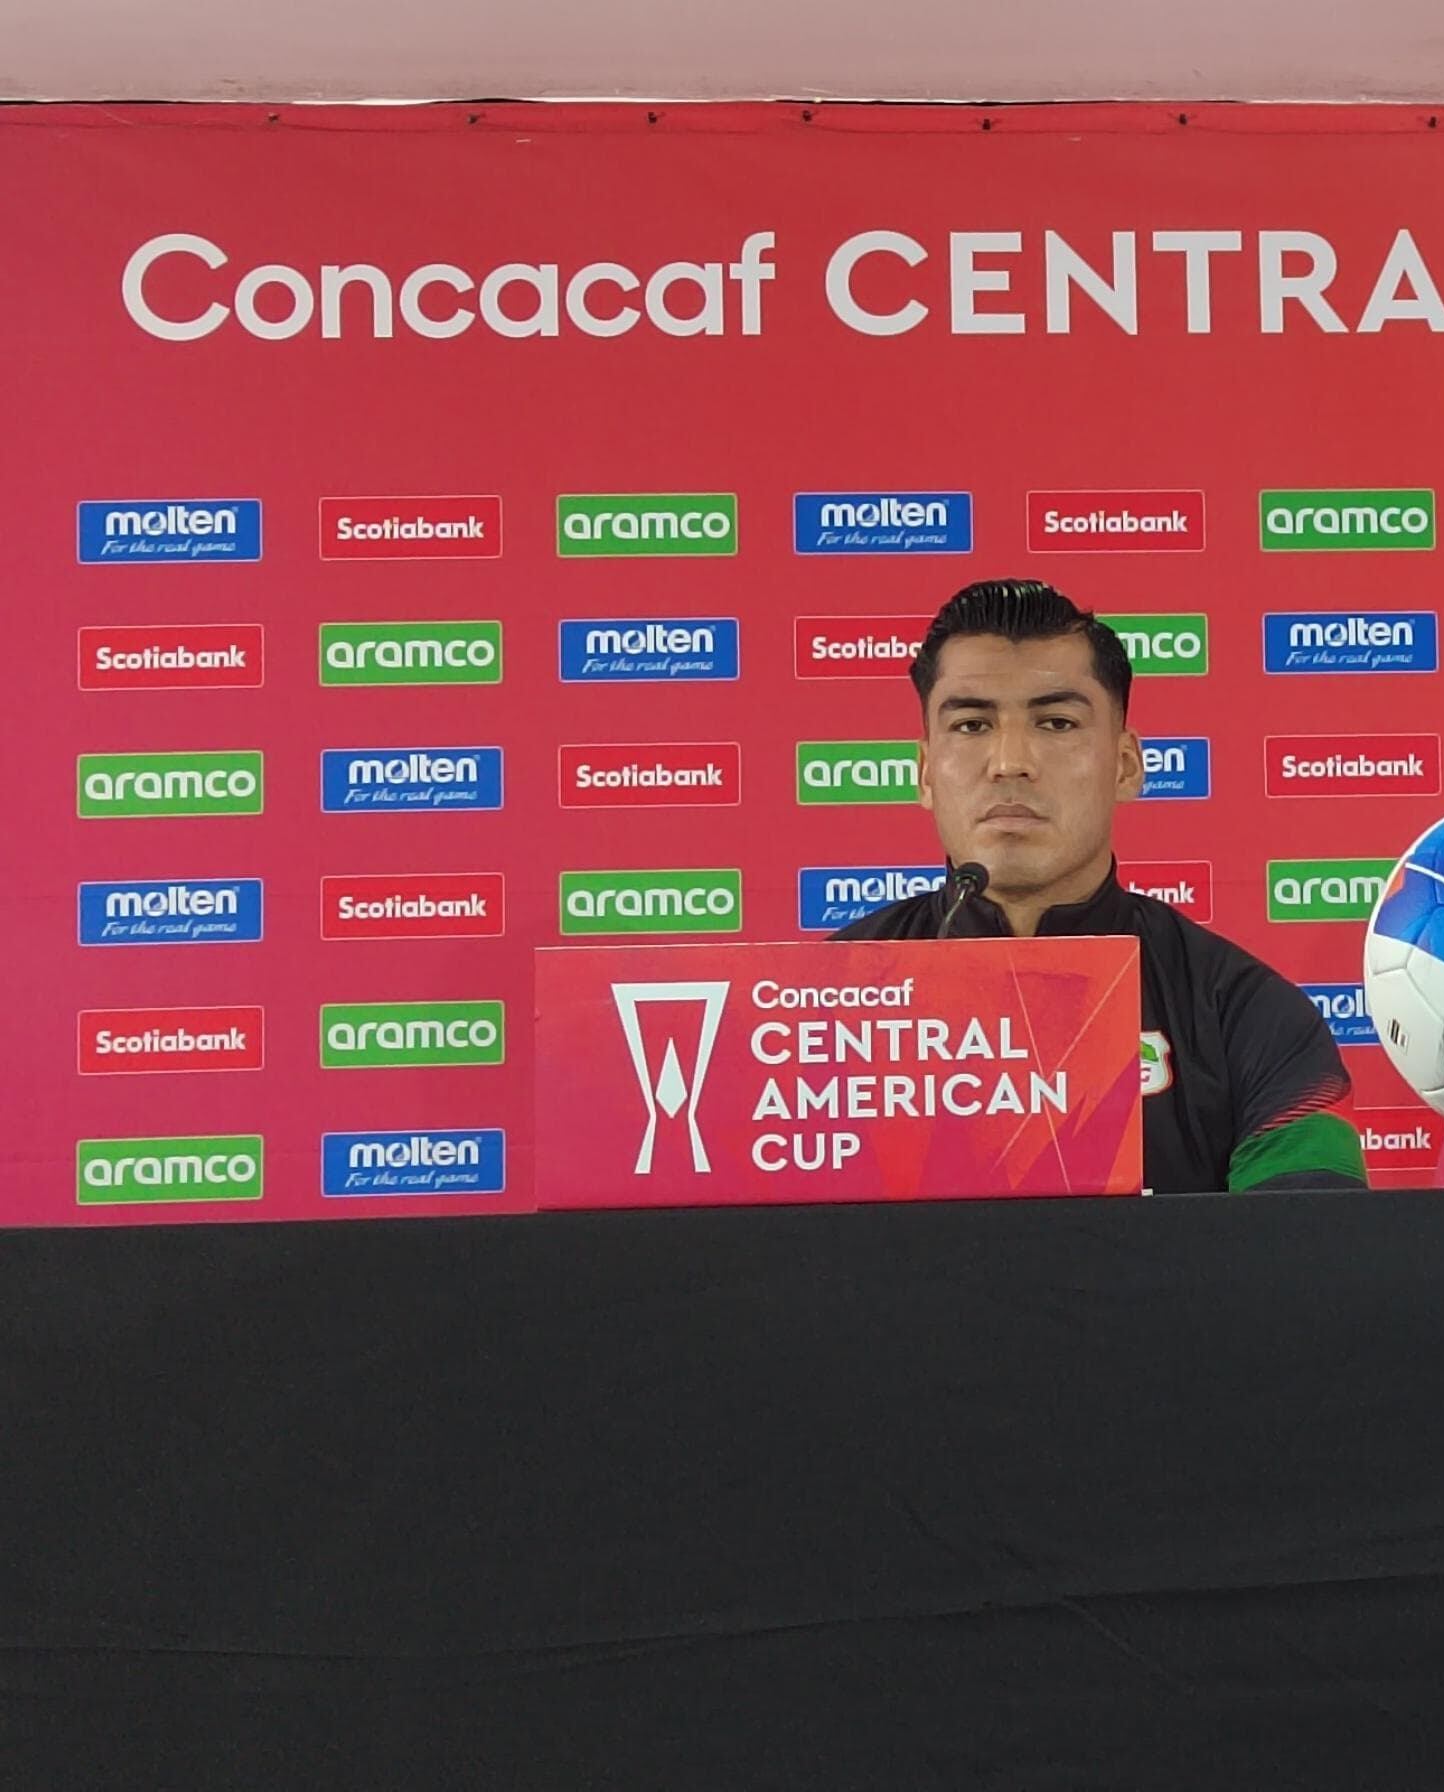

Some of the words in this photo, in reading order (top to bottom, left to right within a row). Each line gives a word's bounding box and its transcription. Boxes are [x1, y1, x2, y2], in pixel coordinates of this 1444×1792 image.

[123, 232, 775, 340] Concacaf
[107, 506, 235, 535] molten
[564, 512, 730, 539] aramco
[822, 499, 946, 526] molten
[1045, 511, 1187, 532] Scotiabank
[1267, 508, 1427, 533] aramco
[338, 516, 483, 539] Scotiabank
[817, 531, 842, 545] For
[844, 530, 869, 543] the
[871, 530, 904, 542] real
[903, 533, 946, 547] game
[102, 540, 128, 555] For
[130, 539, 156, 553] the
[158, 539, 192, 553] real
[191, 542, 235, 557] game
[587, 625, 713, 654] molten
[1118, 632, 1201, 658] mco
[1291, 618, 1412, 646] molten
[97, 645, 245, 669] Scotiabank
[327, 640, 494, 668] aramco
[582, 659, 608, 674] For
[609, 658, 635, 672] the
[637, 658, 671, 672] real
[670, 661, 713, 676] game
[1286, 651, 1311, 665] For
[1312, 650, 1337, 664] the
[1339, 650, 1371, 663] real
[1370, 653, 1412, 667] game
[350, 755, 476, 784] molten
[577, 764, 722, 787] Scotiabank
[804, 759, 918, 787] aram
[1283, 754, 1423, 777] Scotiabank
[85, 770, 256, 800] aramco
[345, 789, 371, 804] For
[372, 788, 398, 802] the
[400, 788, 434, 802] real
[433, 791, 476, 806] game
[107, 887, 236, 916] molten
[567, 888, 734, 916] aramco
[1274, 877, 1387, 904] aram
[339, 894, 486, 918] Scotiabank
[822, 907, 847, 922] For
[102, 921, 128, 936] For
[130, 920, 156, 934] the
[158, 920, 193, 934] real
[192, 923, 236, 938] game
[753, 978, 913, 1008] Concacaf
[96, 1028, 245, 1053] Scotiabank
[328, 1020, 496, 1050] aramco
[751, 1018, 1027, 1064] CENTRAL
[753, 1072, 1066, 1120] AMERICAN
[350, 1137, 478, 1167] molten
[752, 1133, 860, 1170] CUP
[84, 1155, 256, 1186] aramco
[345, 1173, 371, 1188] For
[373, 1172, 399, 1186] the
[401, 1171, 435, 1185] real
[434, 1175, 478, 1190] game
